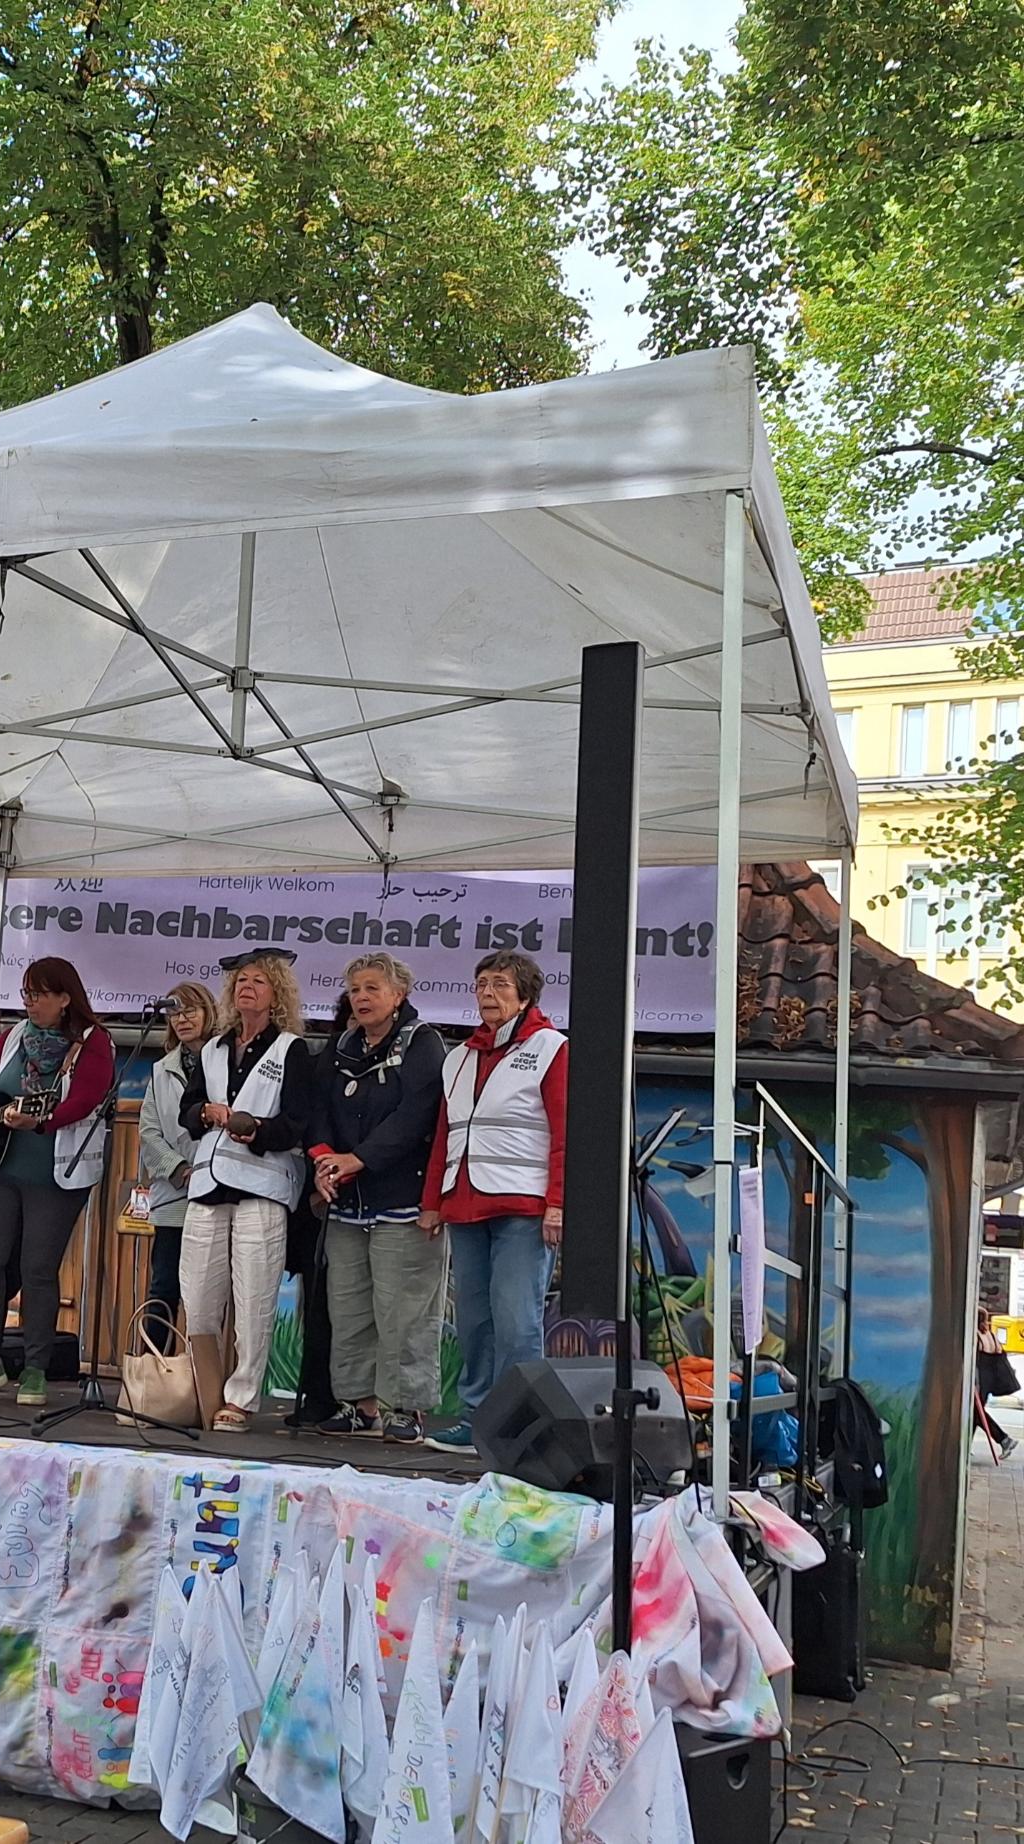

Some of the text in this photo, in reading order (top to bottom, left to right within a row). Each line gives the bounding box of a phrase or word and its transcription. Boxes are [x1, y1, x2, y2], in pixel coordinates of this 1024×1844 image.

[198, 876, 335, 893] Hartelijk Welkom
[95, 902, 463, 949] Nachbarschaft
[474, 915, 544, 952] ist
[165, 961, 195, 976] Hoş
[635, 1009, 704, 1022] elcome
[79, 1645, 103, 1682] ALLE
